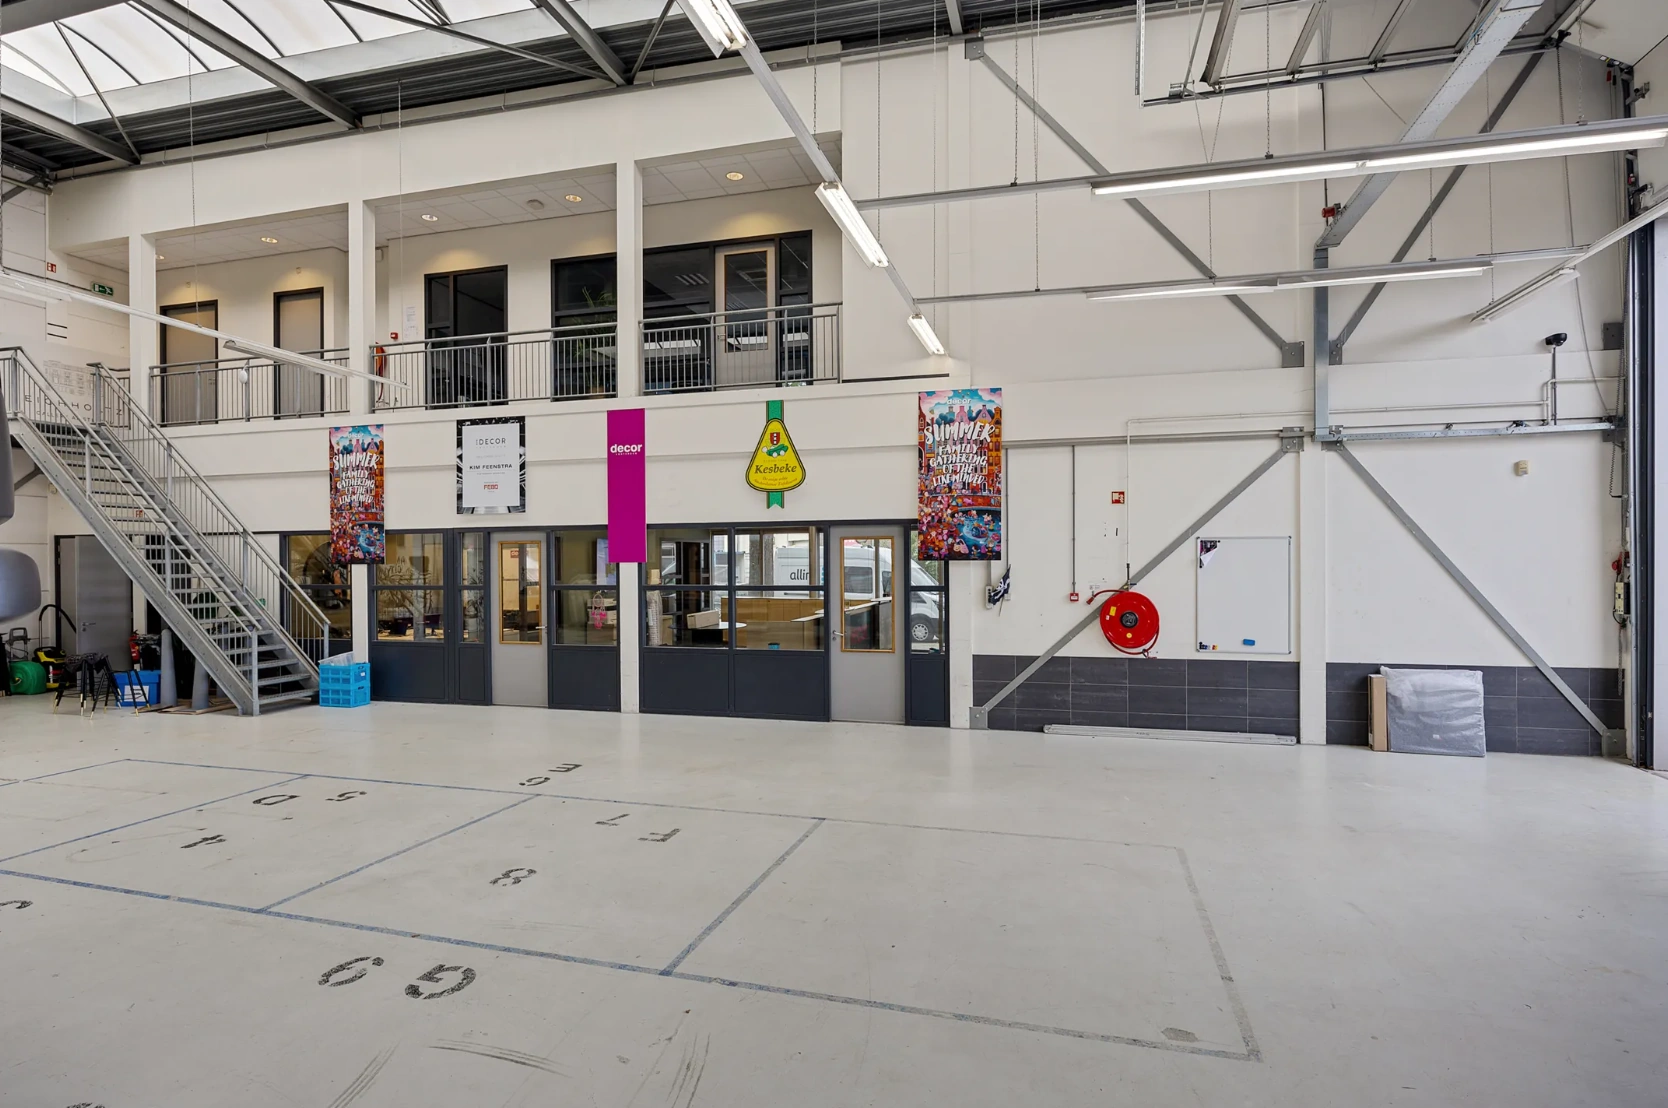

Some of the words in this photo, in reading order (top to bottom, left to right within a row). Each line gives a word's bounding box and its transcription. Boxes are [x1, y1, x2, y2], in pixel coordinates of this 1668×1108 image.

[924, 421, 995, 444] SUMMER
[610, 443, 642, 453] decor
[939, 443, 979, 455] FAMILY
[333, 452, 379, 470] SUMMER
[929, 453, 988, 467] GATHERING
[754, 463, 797, 474] Kesbeke
[943, 463, 955, 474] OF
[955, 462, 975, 474] THE
[342, 470, 369, 480] FAMILY
[337, 478, 375, 489] GATHERING
[354, 486, 366, 495] THE
